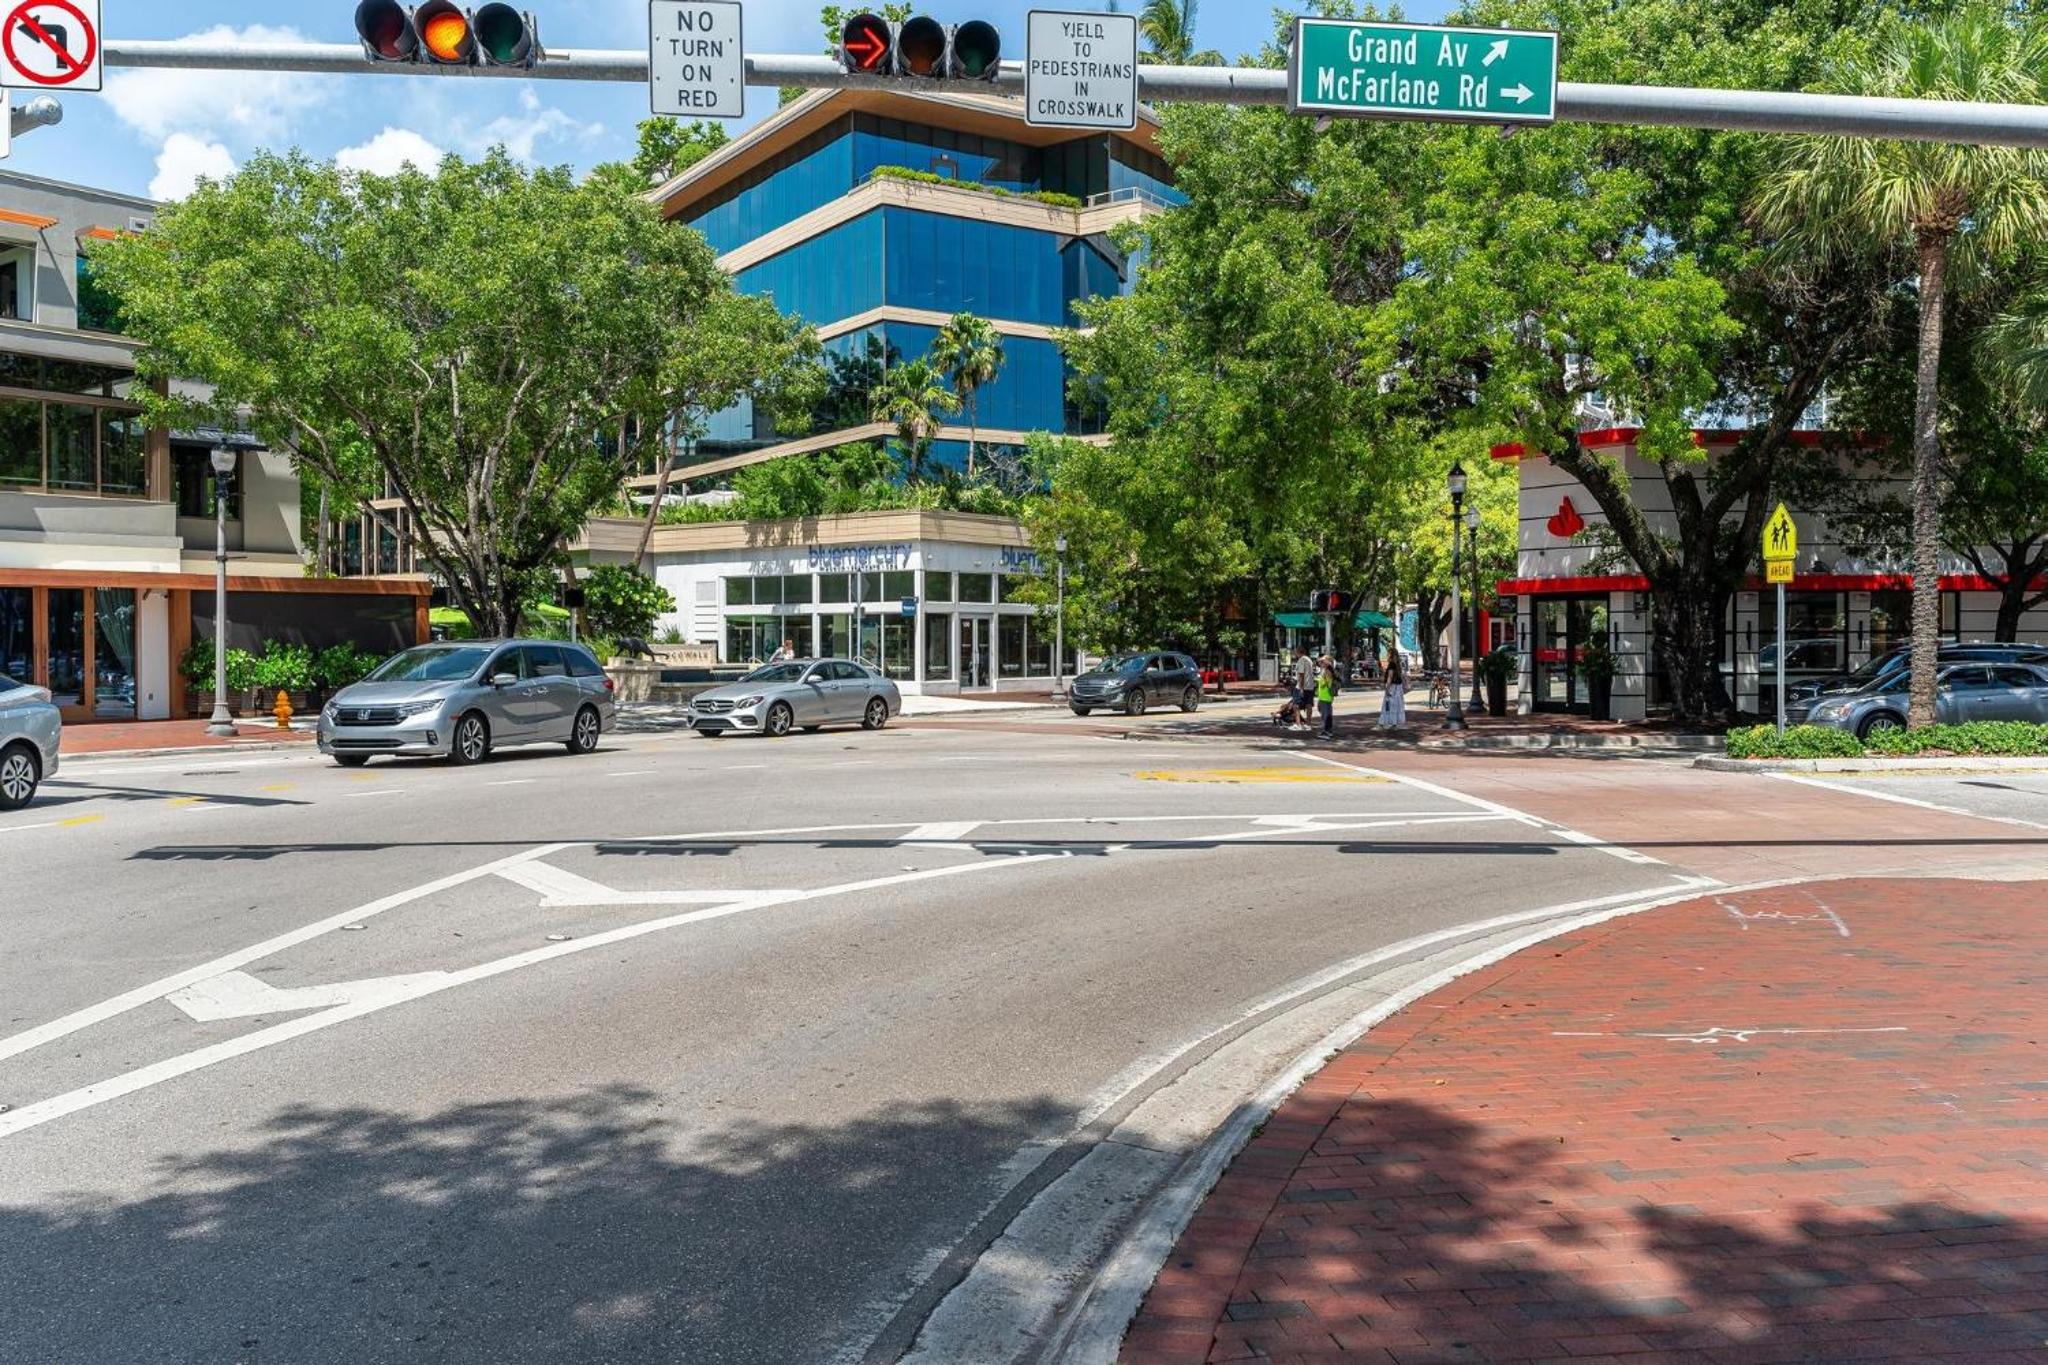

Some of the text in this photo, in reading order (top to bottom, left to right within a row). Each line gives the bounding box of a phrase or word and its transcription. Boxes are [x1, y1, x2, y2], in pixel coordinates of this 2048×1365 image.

[678, 11, 713, 32] NO
[1062, 22, 1104, 39] YIELD
[669, 39, 723, 57] TURN
[1073, 42, 1091, 57] TO
[1348, 29, 1468, 67] Grand Av
[682, 64, 711, 82] ON
[1031, 60, 1132, 79] PEDESTRIANS
[1075, 81, 1088, 97] IN
[1317, 66, 1488, 108] McFarlane Rd
[678, 89, 718, 107] RED
[1038, 99, 1124, 118] CROSSWALK
[809, 543, 913, 569] bluemercury
[1770, 565, 1791, 577] AHEAD
